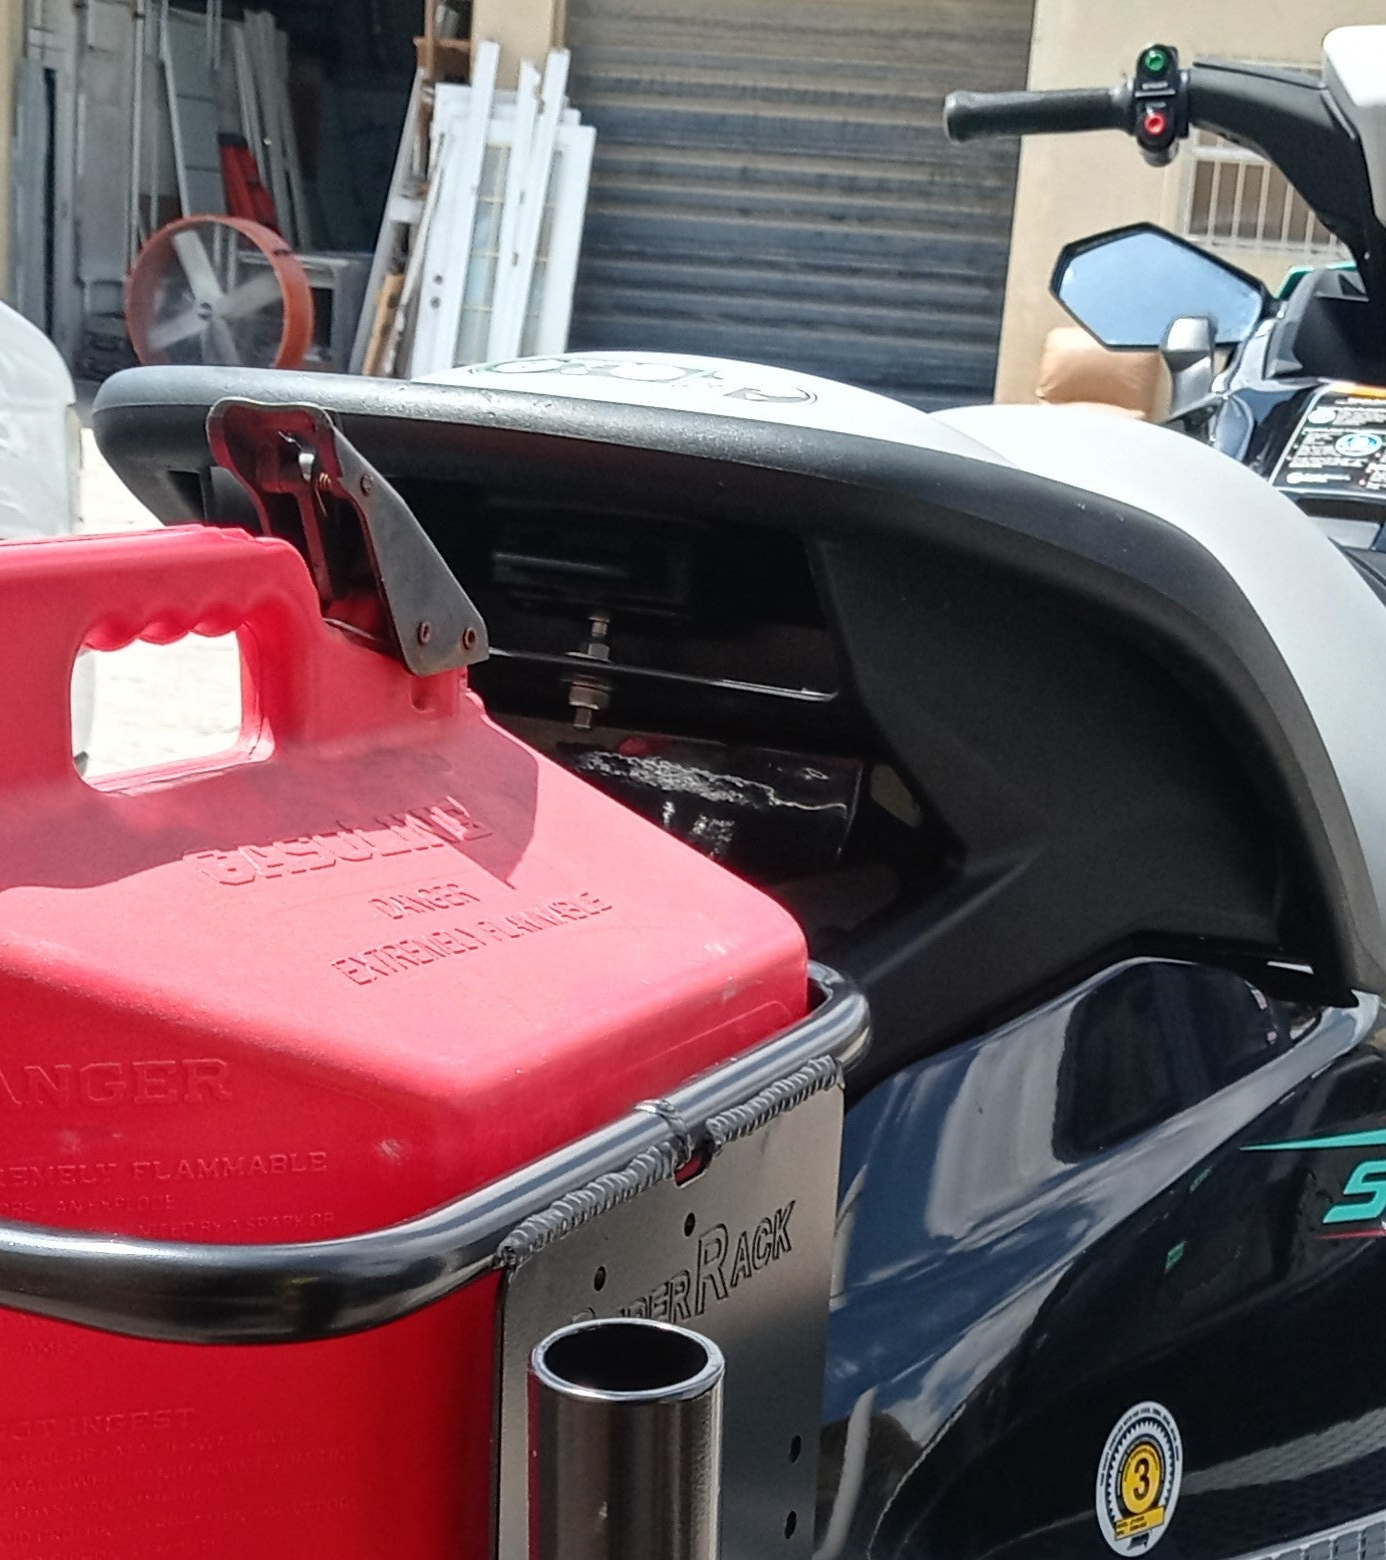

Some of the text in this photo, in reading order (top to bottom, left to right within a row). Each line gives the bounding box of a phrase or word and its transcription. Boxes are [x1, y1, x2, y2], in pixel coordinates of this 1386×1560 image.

[367, 883, 481, 920] DANGER
[329, 891, 613, 986] EXTREMELY FLAMMABLE
[130, 1150, 328, 1183] FLAMMABLE
[68, 1407, 196, 1438] INGEST
[1133, 1457, 1151, 1501] 3
